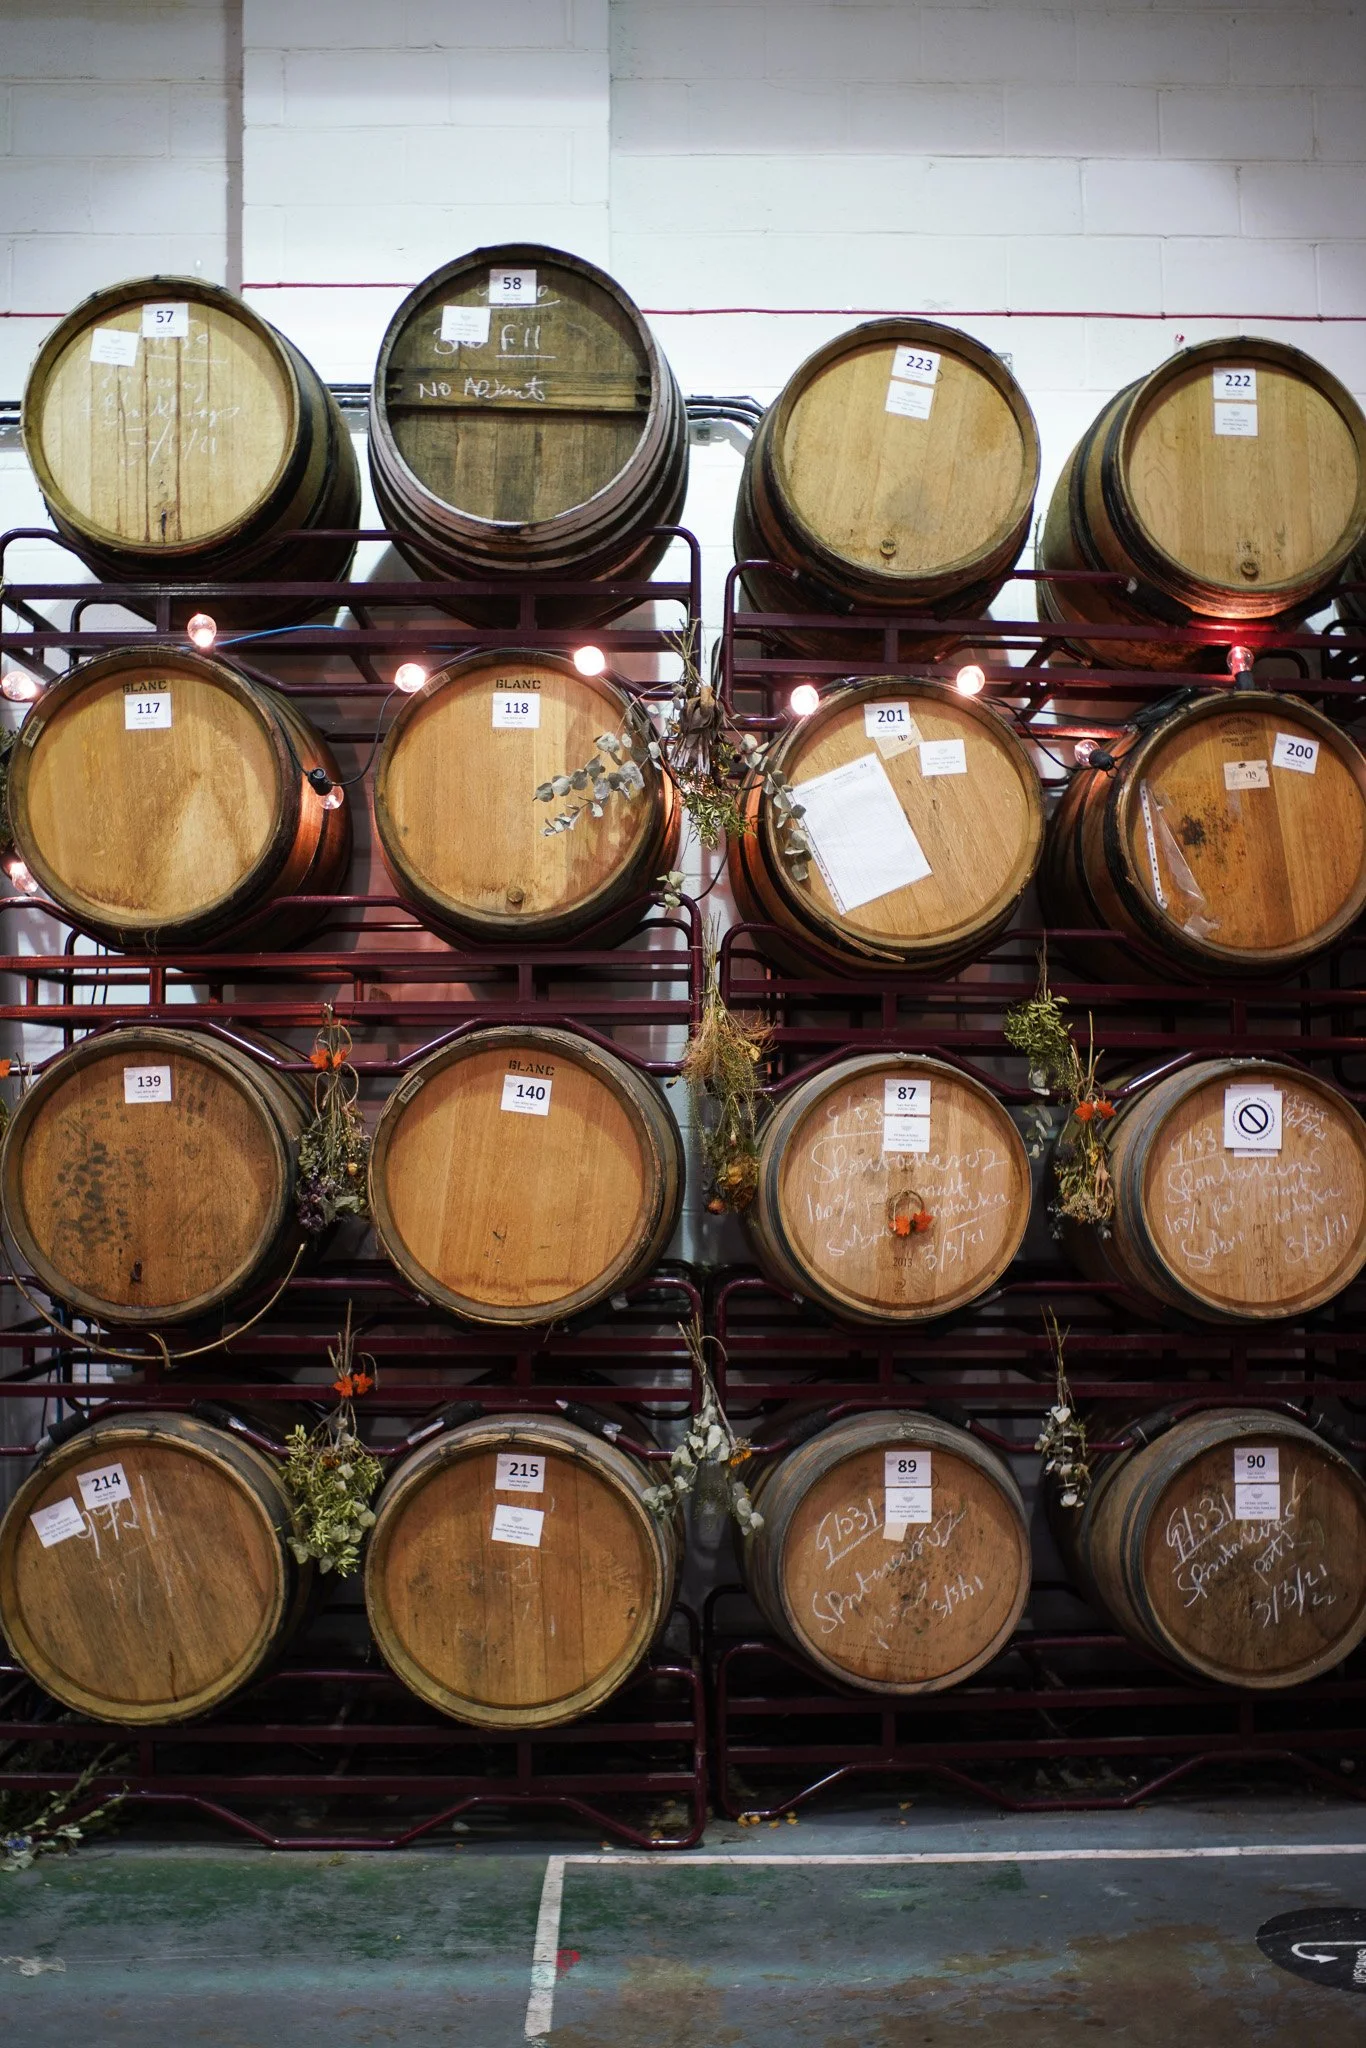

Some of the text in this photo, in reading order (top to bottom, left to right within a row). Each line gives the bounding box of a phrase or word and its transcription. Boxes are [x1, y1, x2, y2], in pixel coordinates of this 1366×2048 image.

[503, 277, 522, 290] 58
[156, 310, 174, 323] 57
[906, 355, 933, 371] 223
[1225, 374, 1251, 387] 222
[122, 680, 167, 693] BLANC
[496, 679, 541, 689] BLANC
[137, 702, 160, 714] 117
[505, 702, 529, 714] 118
[877, 709, 905, 723] 201
[1286, 742, 1313, 759] 200
[508, 1060, 555, 1076] BLANC
[137, 1075, 161, 1088] 139
[516, 1084, 546, 1100] 140
[898, 1086, 917, 1100] 87
[898, 1459, 917, 1473] 89
[1247, 1455, 1265, 1468] 90
[508, 1462, 539, 1478] 215
[91, 1472, 122, 1492] 214
